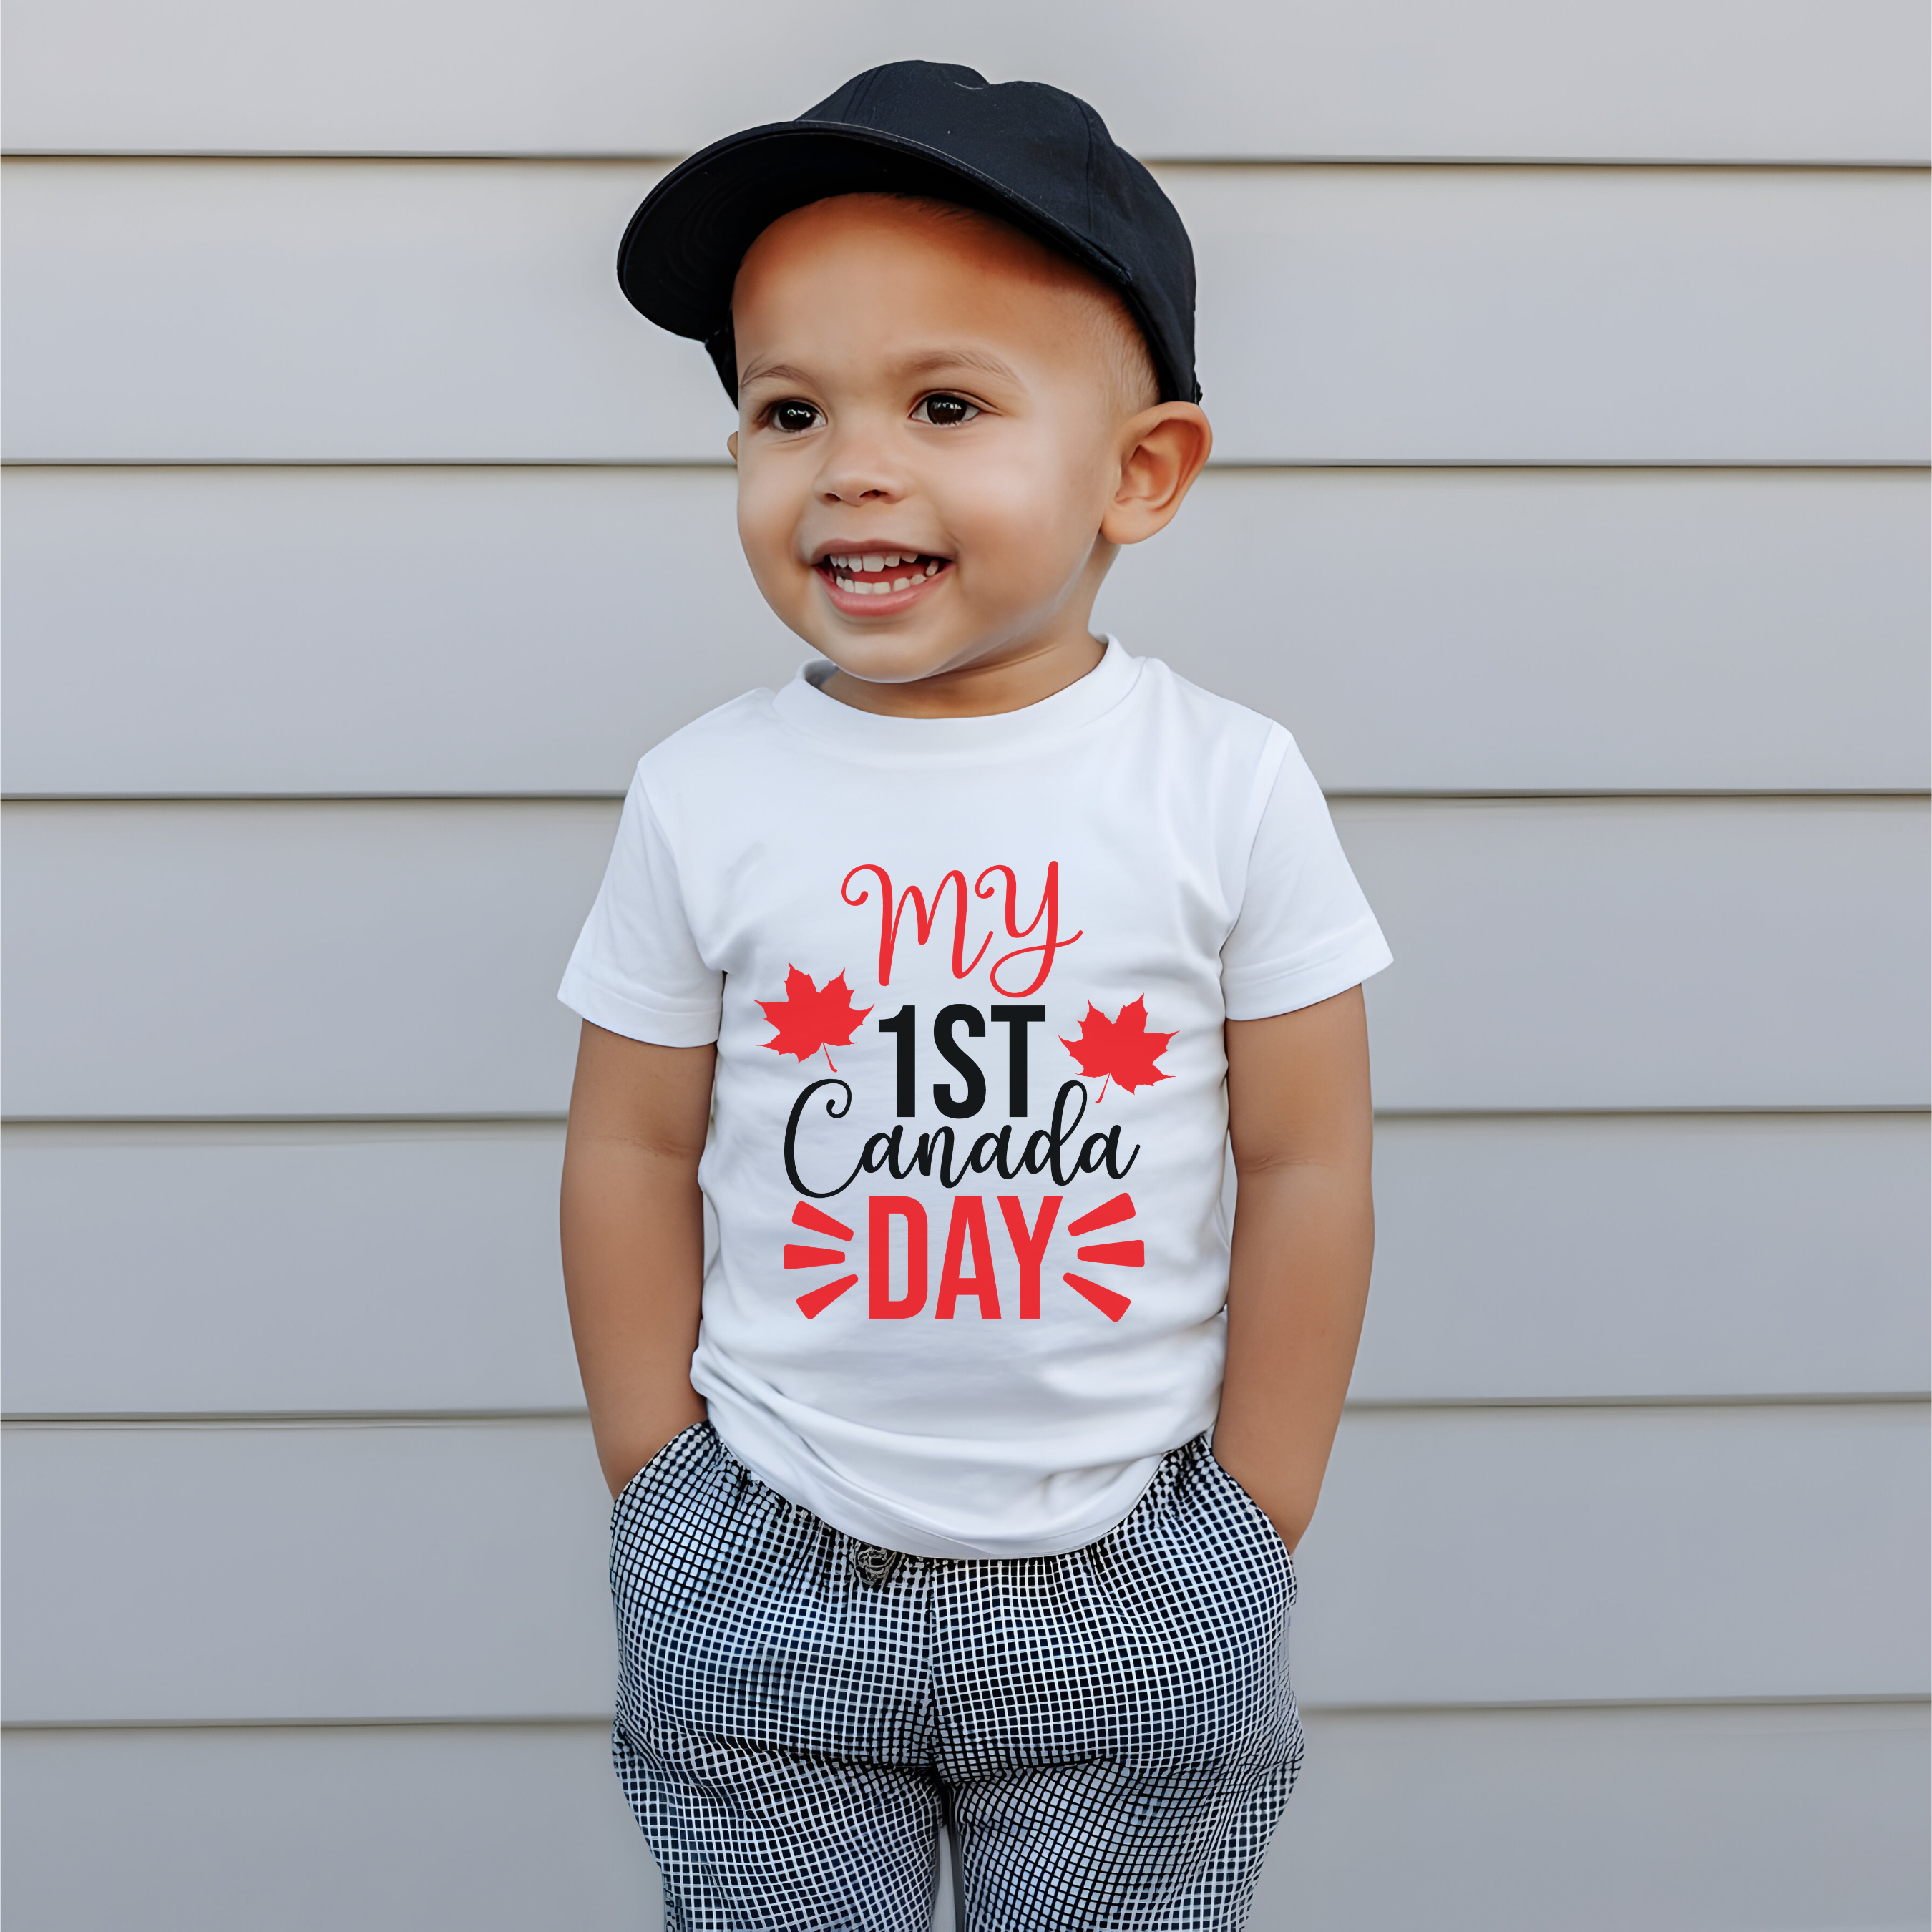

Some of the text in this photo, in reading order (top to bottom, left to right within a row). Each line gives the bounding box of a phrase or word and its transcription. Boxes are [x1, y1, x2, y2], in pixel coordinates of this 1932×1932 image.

[878, 1003, 1046, 1119] 1ST
[784, 1078, 1141, 1199] Canada
[869, 1195, 1064, 1319] DAY
